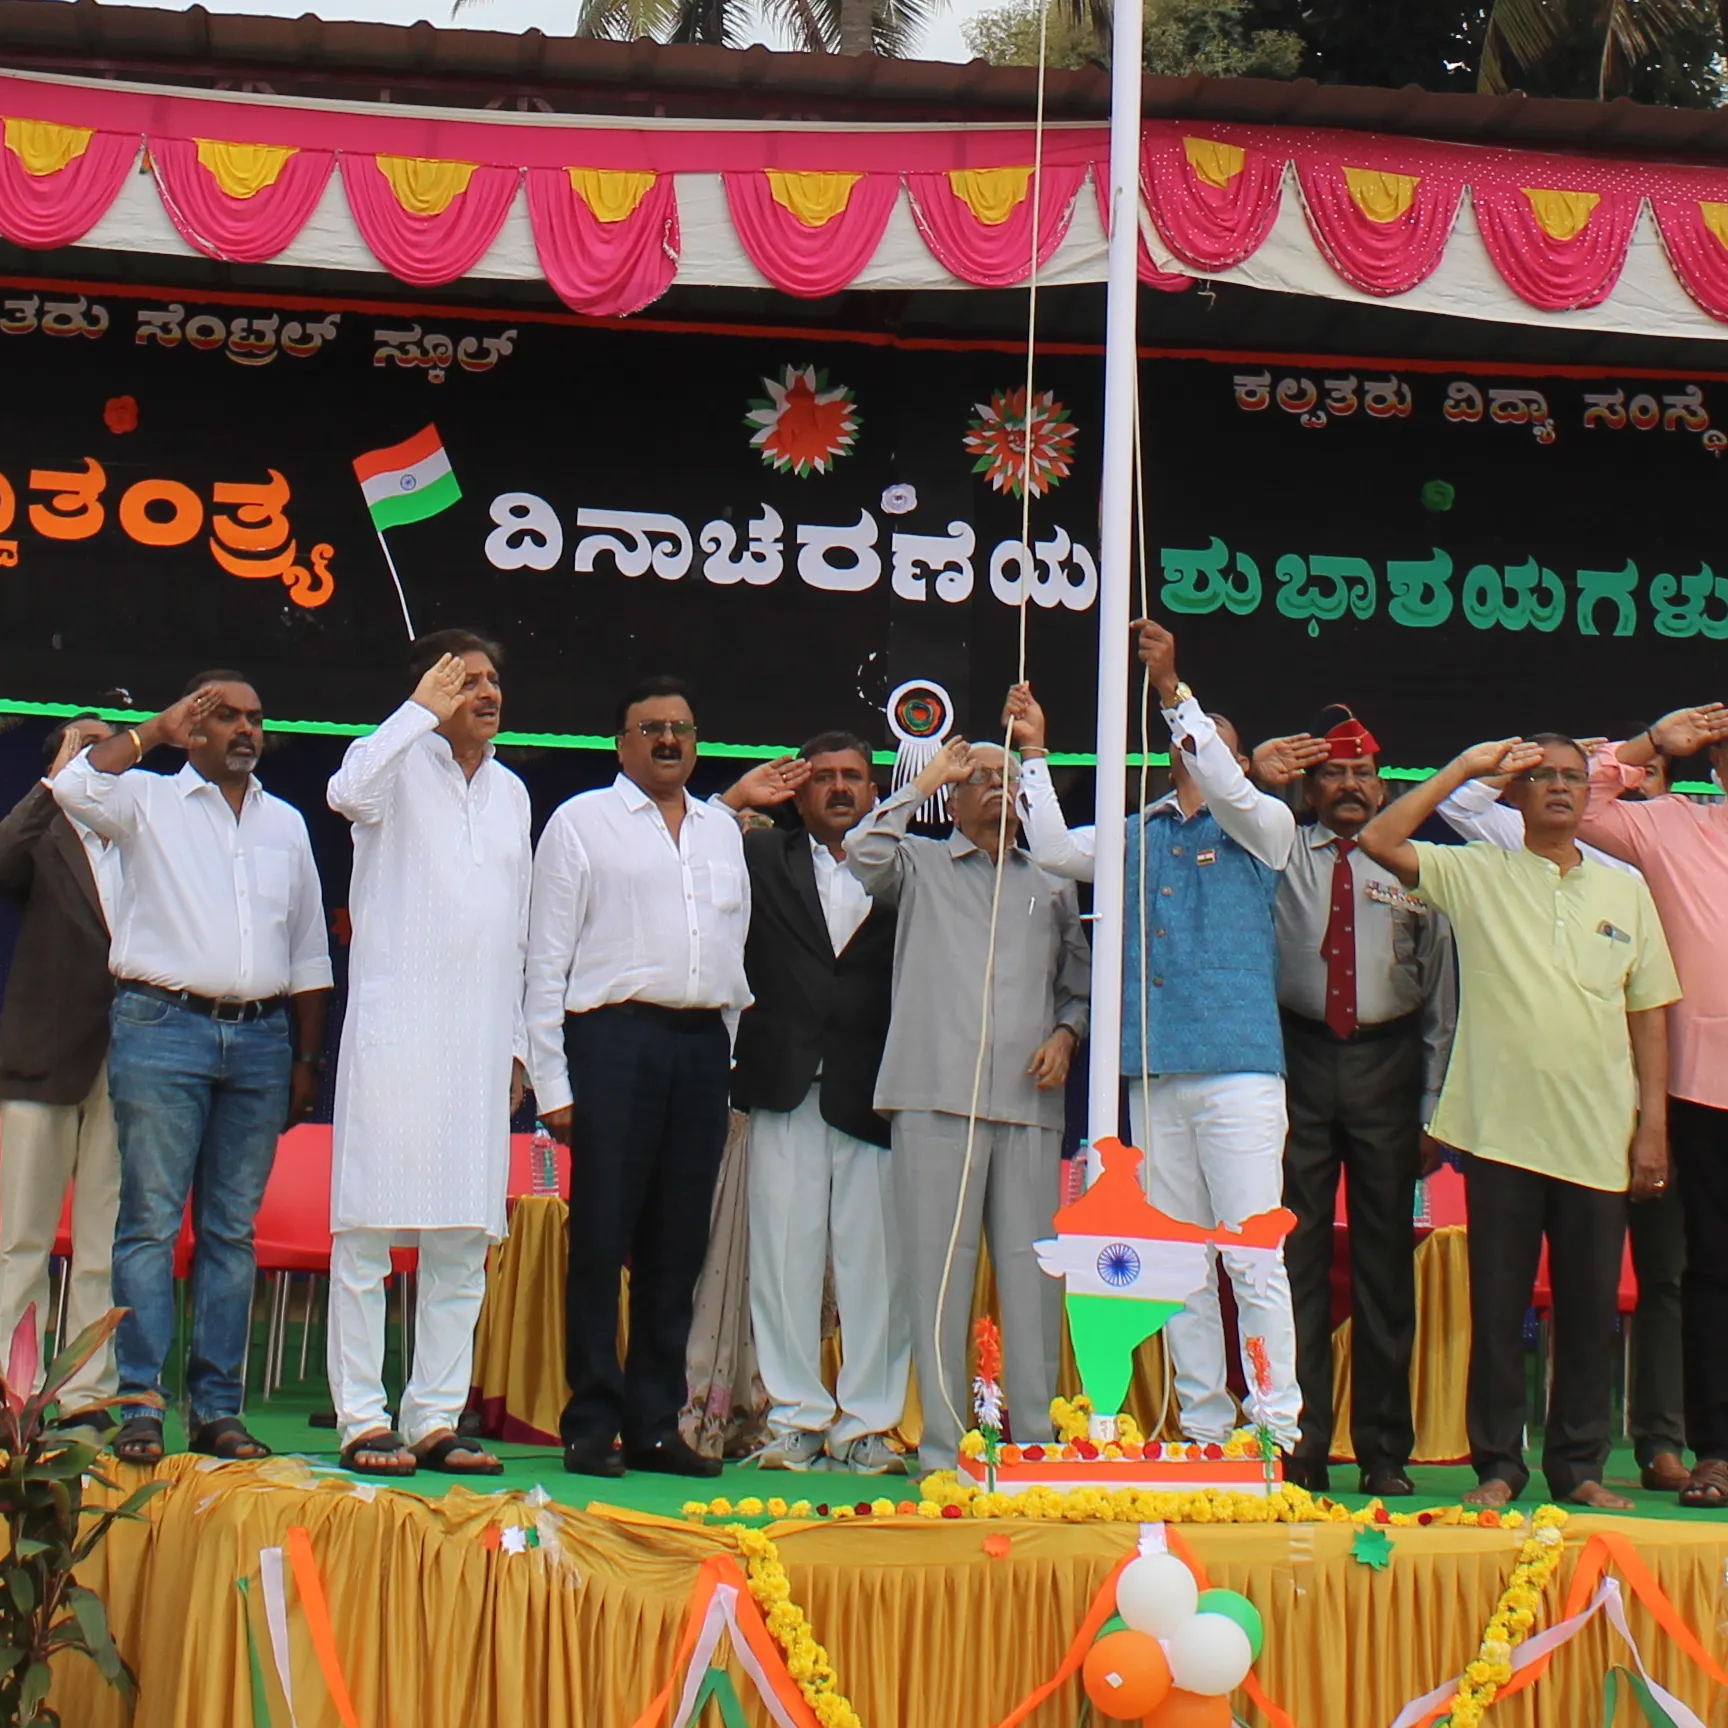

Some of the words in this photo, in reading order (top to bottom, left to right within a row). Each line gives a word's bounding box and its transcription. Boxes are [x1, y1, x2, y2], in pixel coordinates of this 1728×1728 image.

[135, 304, 341, 366] ಸೆಂಟ್ರಲ್
[373, 323, 517, 384] ಸ್ಕೂಲ್
[1233, 369, 1412, 428] ಕಲ್ಪತರು
[1443, 380, 1556, 445] ವಿದ್ಯಾ
[1583, 384, 1728, 458] ಸಂಸ್ಥೆ
[485, 492, 1098, 611] ದಿನಾಚರಣೆಯ
